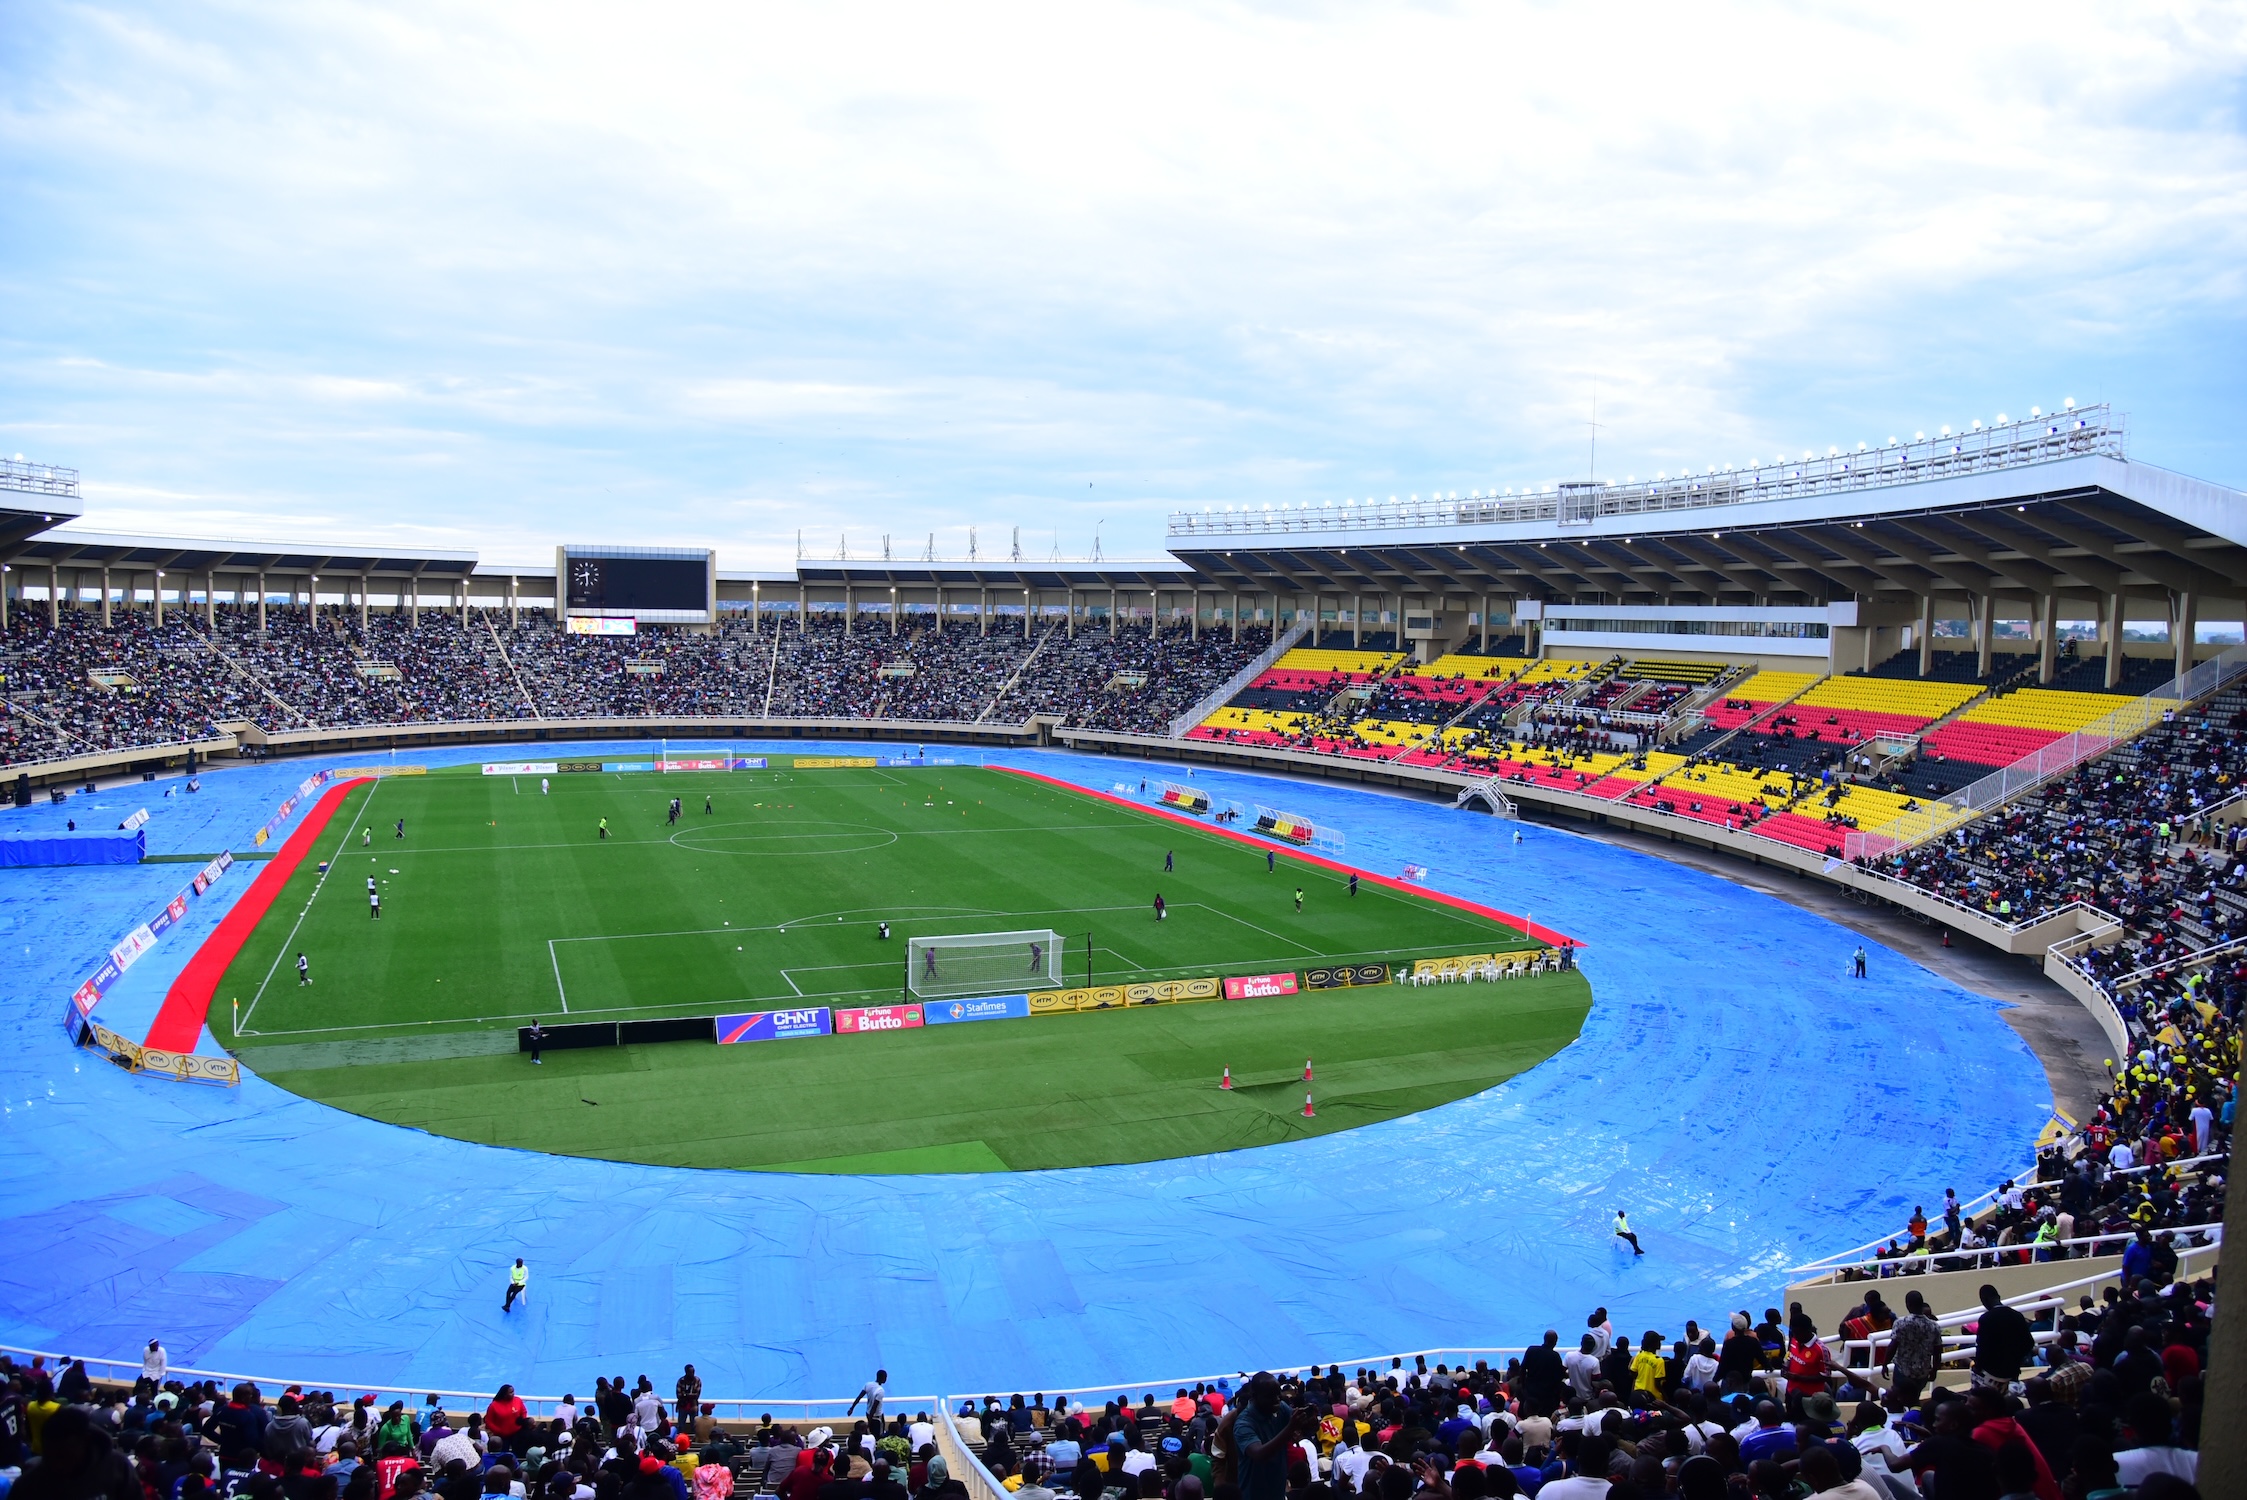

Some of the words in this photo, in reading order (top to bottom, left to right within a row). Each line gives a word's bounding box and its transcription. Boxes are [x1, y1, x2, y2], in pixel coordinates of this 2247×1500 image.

[1243, 983, 1281, 998] Butto
[863, 1008, 892, 1017] Fortune
[966, 1002, 1007, 1013] StarTimes
[858, 1016, 902, 1031] Butto
